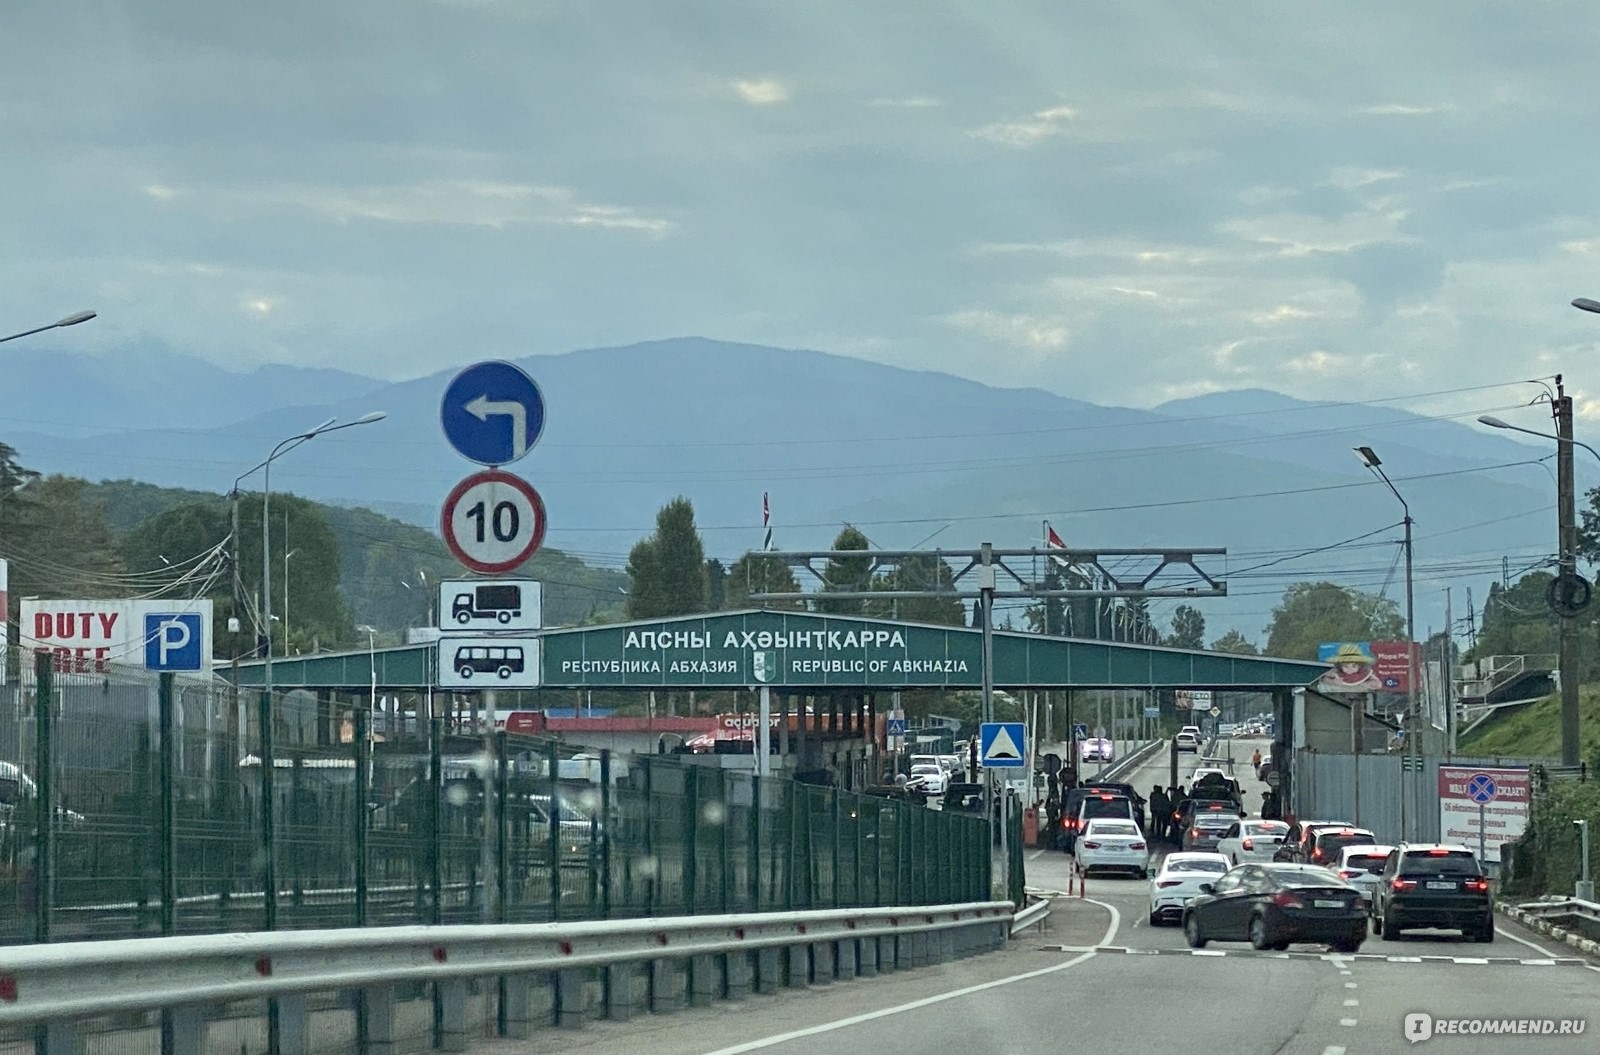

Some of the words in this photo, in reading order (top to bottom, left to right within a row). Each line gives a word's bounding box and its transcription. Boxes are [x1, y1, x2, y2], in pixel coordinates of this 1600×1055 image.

[466, 501, 520, 543] 10
[34, 612, 119, 639] DUTY
[159, 620, 190, 665] P
[33, 647, 111, 673] REE
[562, 660, 661, 673] РЕСПУБЛИКА
[670, 660, 737, 673] АБХАЗИЯ
[792, 660, 864, 672] REPUBLIC
[869, 660, 889, 672] OF
[892, 660, 968, 672] ABKHAZIA
[725, 718, 780, 729] aquaor
